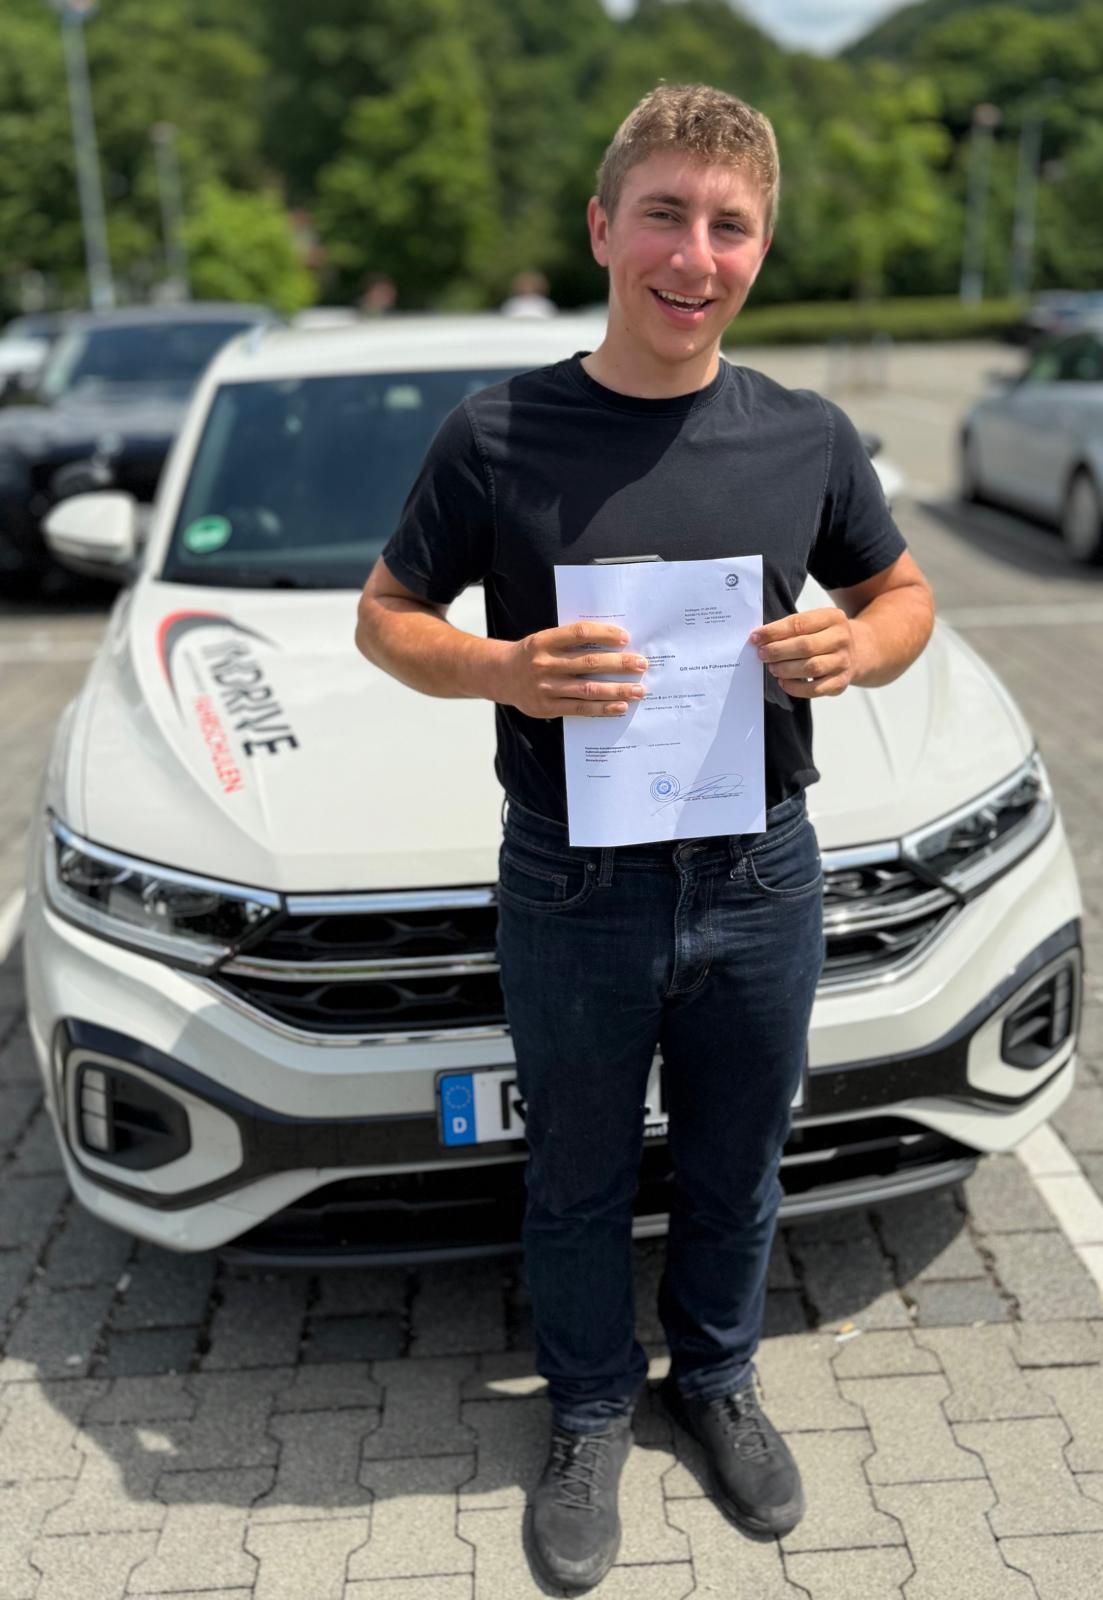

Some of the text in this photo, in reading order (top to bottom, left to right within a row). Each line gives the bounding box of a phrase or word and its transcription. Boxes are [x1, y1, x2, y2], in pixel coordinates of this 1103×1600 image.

[194, 694, 243, 794] FAHRSCHULEN
[202, 639, 300, 757] INDRIVE
[452, 1116, 467, 1134] D
